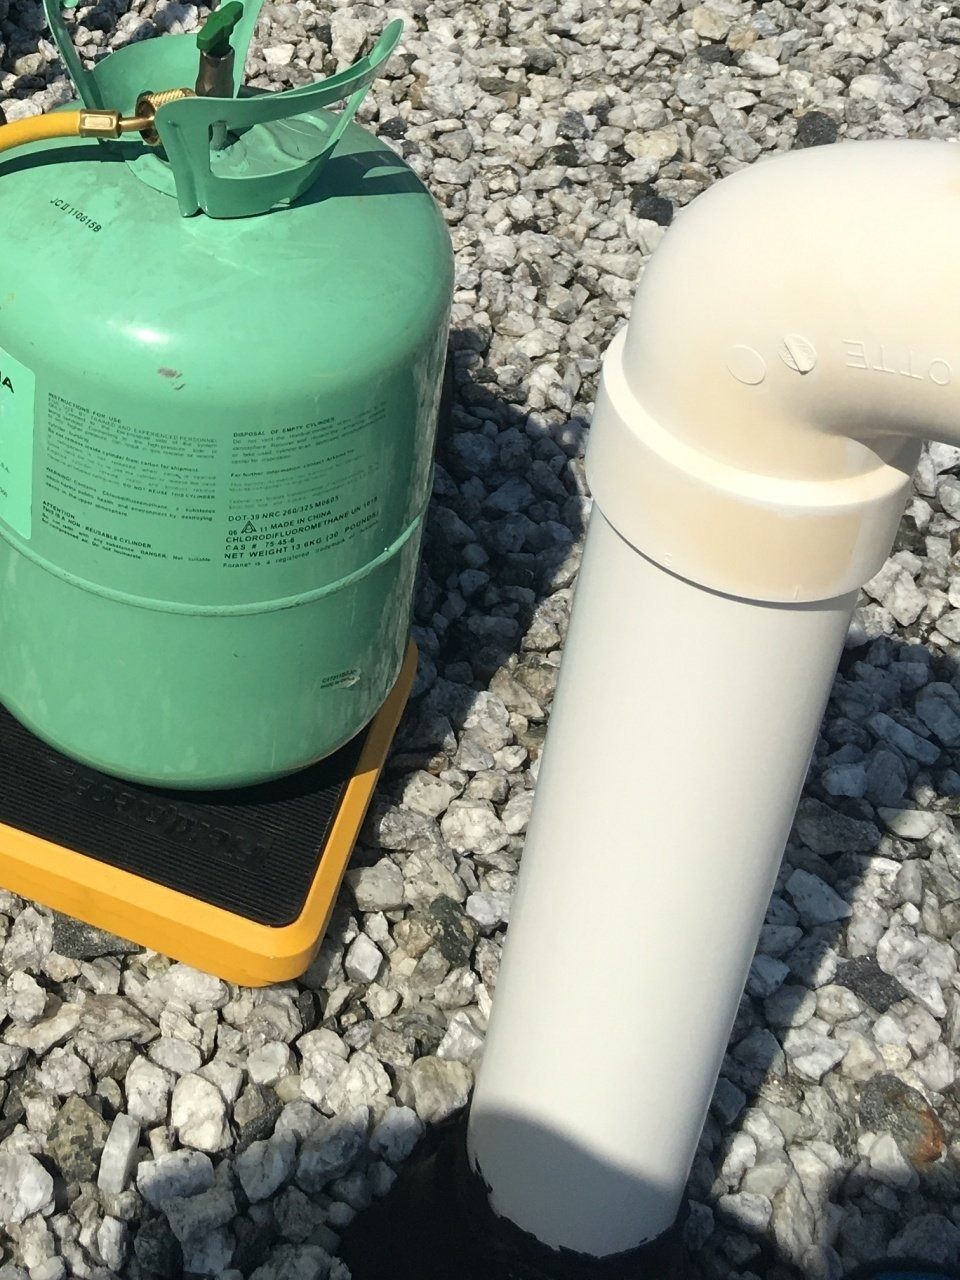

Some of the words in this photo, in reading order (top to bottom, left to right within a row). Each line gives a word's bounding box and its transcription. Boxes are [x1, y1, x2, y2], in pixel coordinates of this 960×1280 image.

[48, 392, 90, 414] INSTRUCTIONS
[93, 411, 106, 419] FOR
[109, 416, 121, 424] USE
[282, 425, 303, 434] EMPTY
[42, 500, 75, 519] ATTENTION
[262, 511, 280, 519] NRC
[226, 510, 348, 543] CHLORODIFLUOROMETHANE
[270, 517, 295, 530] MADE
[297, 516, 305, 524] IN
[307, 510, 332, 521] CHINA
[85, 526, 117, 541] REUSABLE
[119, 537, 152, 548] CYLINDER
[249, 546, 288, 557] WEIGHT
